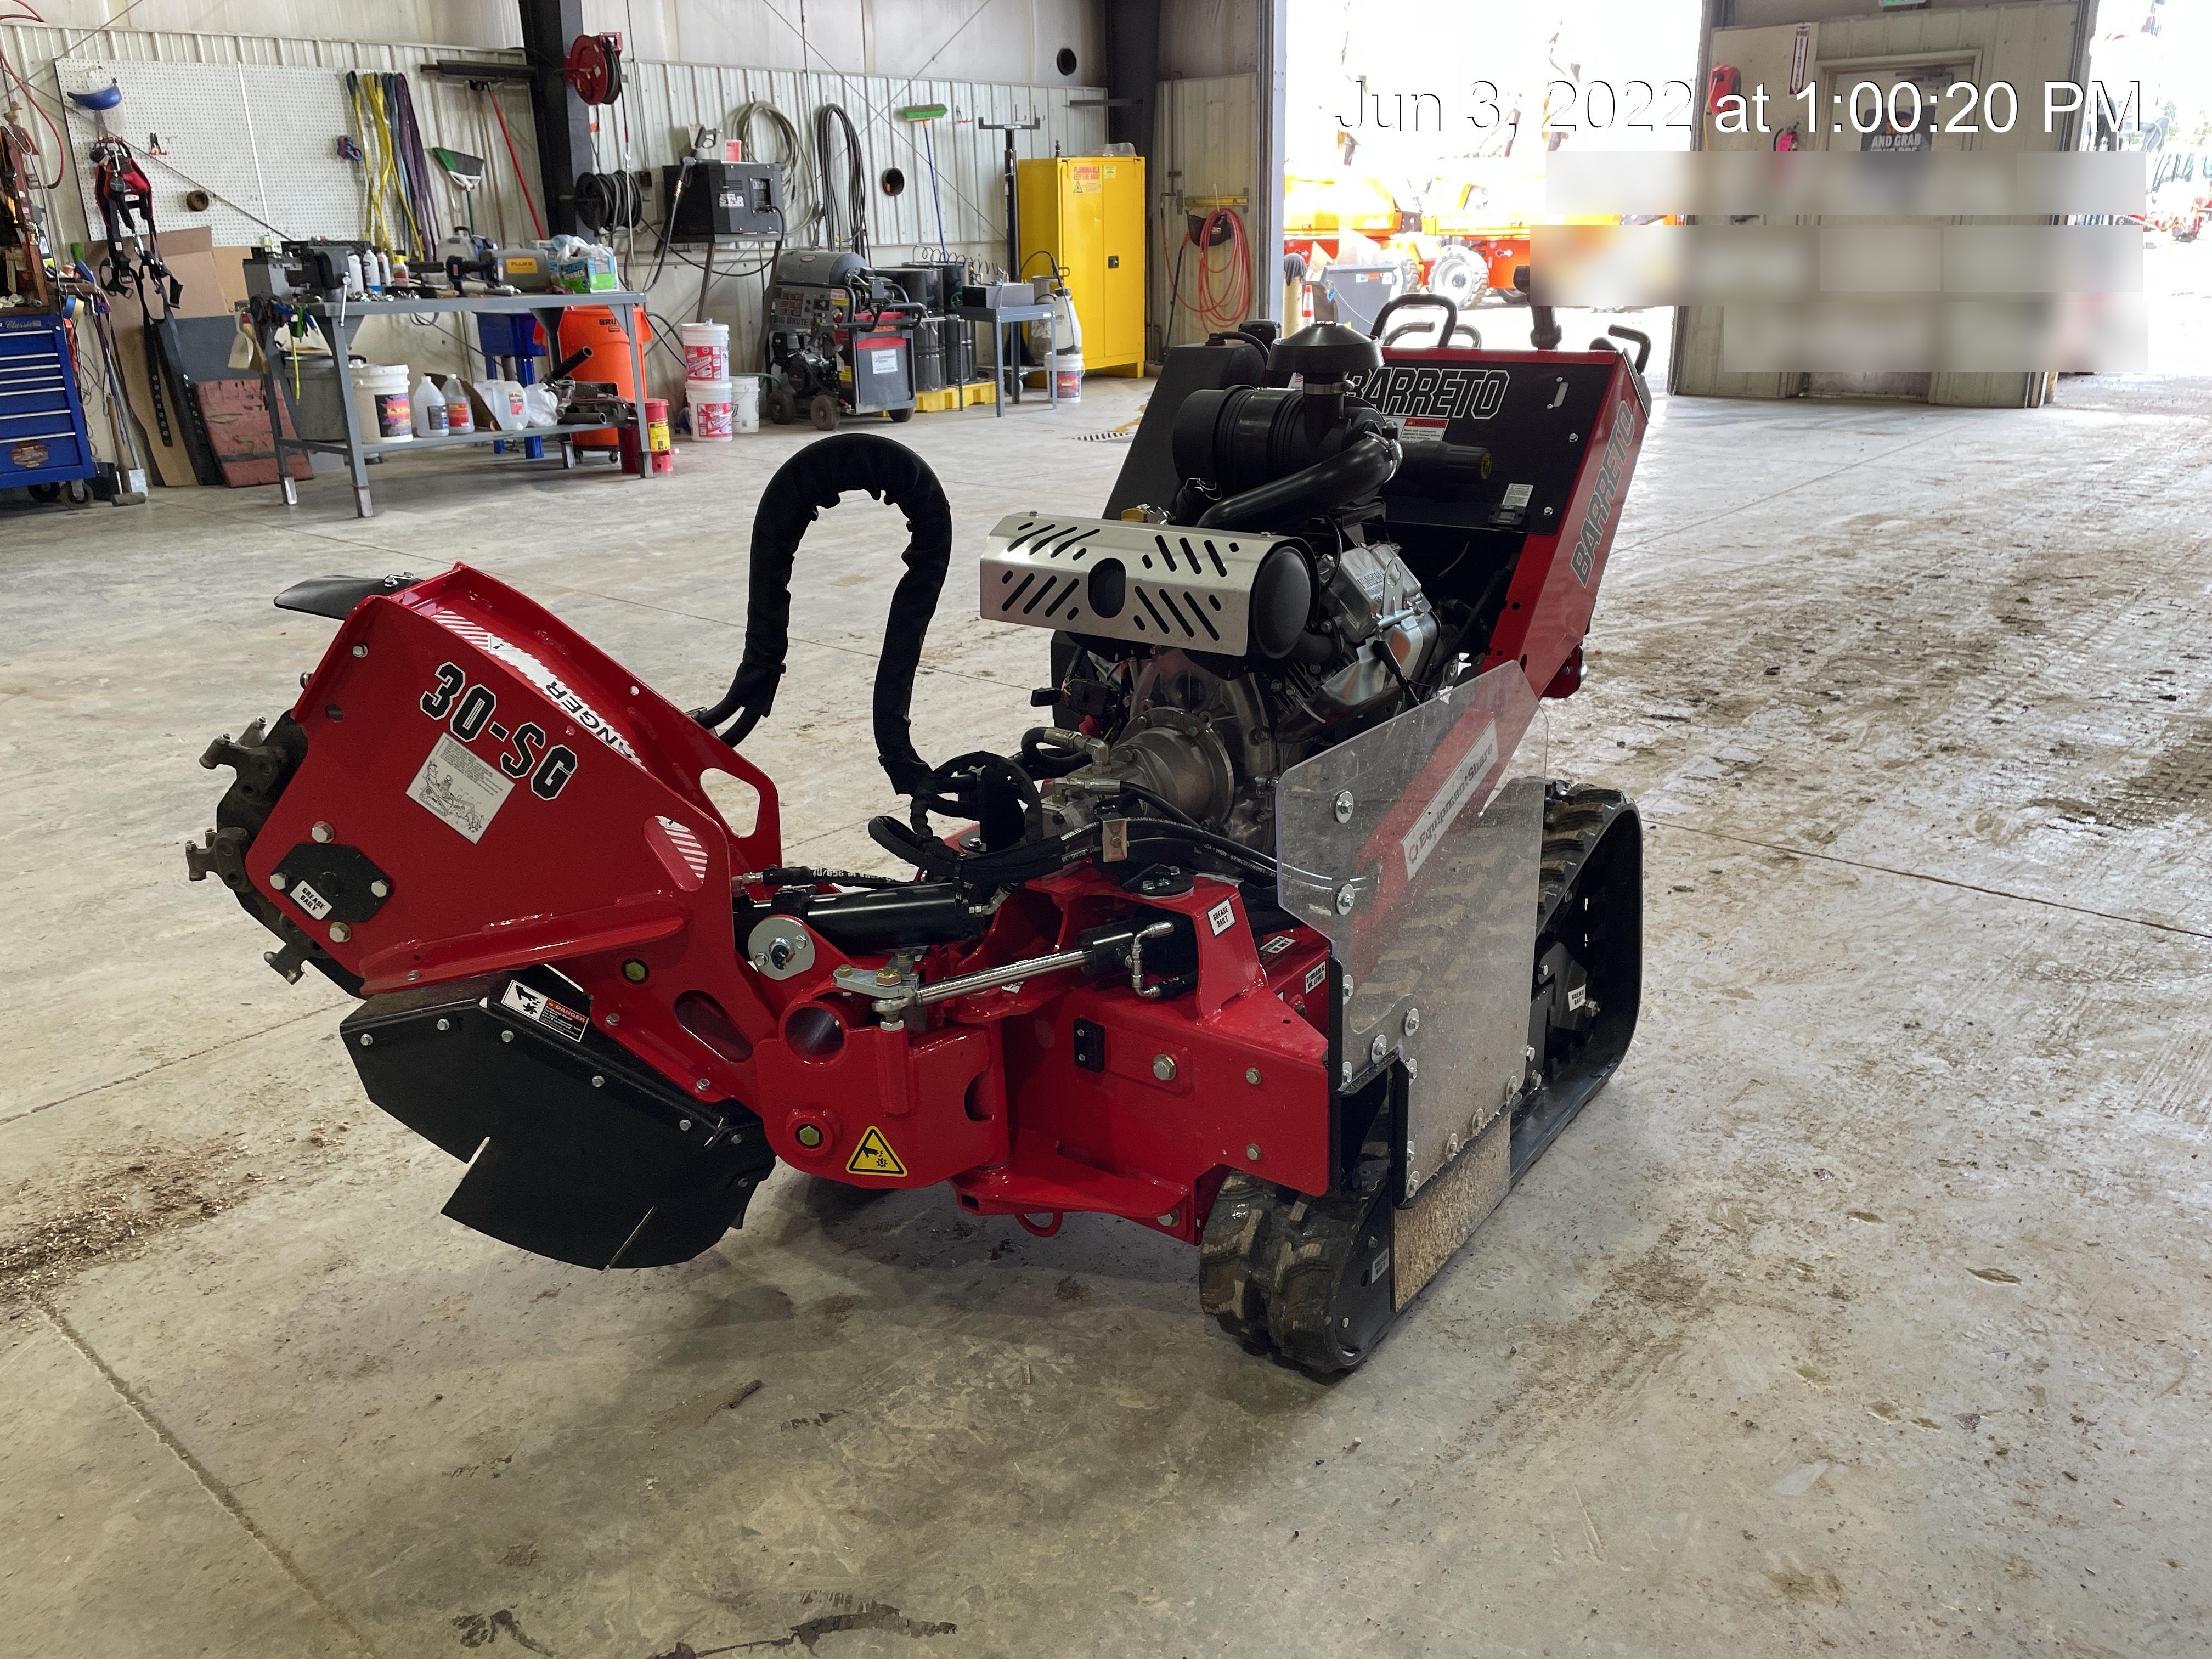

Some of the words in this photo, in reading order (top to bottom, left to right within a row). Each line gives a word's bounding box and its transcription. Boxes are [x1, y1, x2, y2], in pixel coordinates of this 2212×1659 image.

[1871, 134, 1892, 148] AND
[1894, 133, 1921, 147] GRAB
[719, 196, 745, 207] STAR
[787, 317, 808, 326] BRUTE
[1570, 400, 1635, 589] BARRETO
[546, 681, 633, 758] ANGER
[420, 661, 578, 801] 30-SG
[1419, 743, 1493, 846] EquipmentShare
[300, 894, 318, 911] DAILY
[302, 888, 326, 910] GREASE
[1212, 905, 1228, 921] GREASE
[1217, 916, 1229, 928] DAILY
[1313, 973, 1323, 985] LEVEL
[555, 1005, 585, 1024] DANGER
